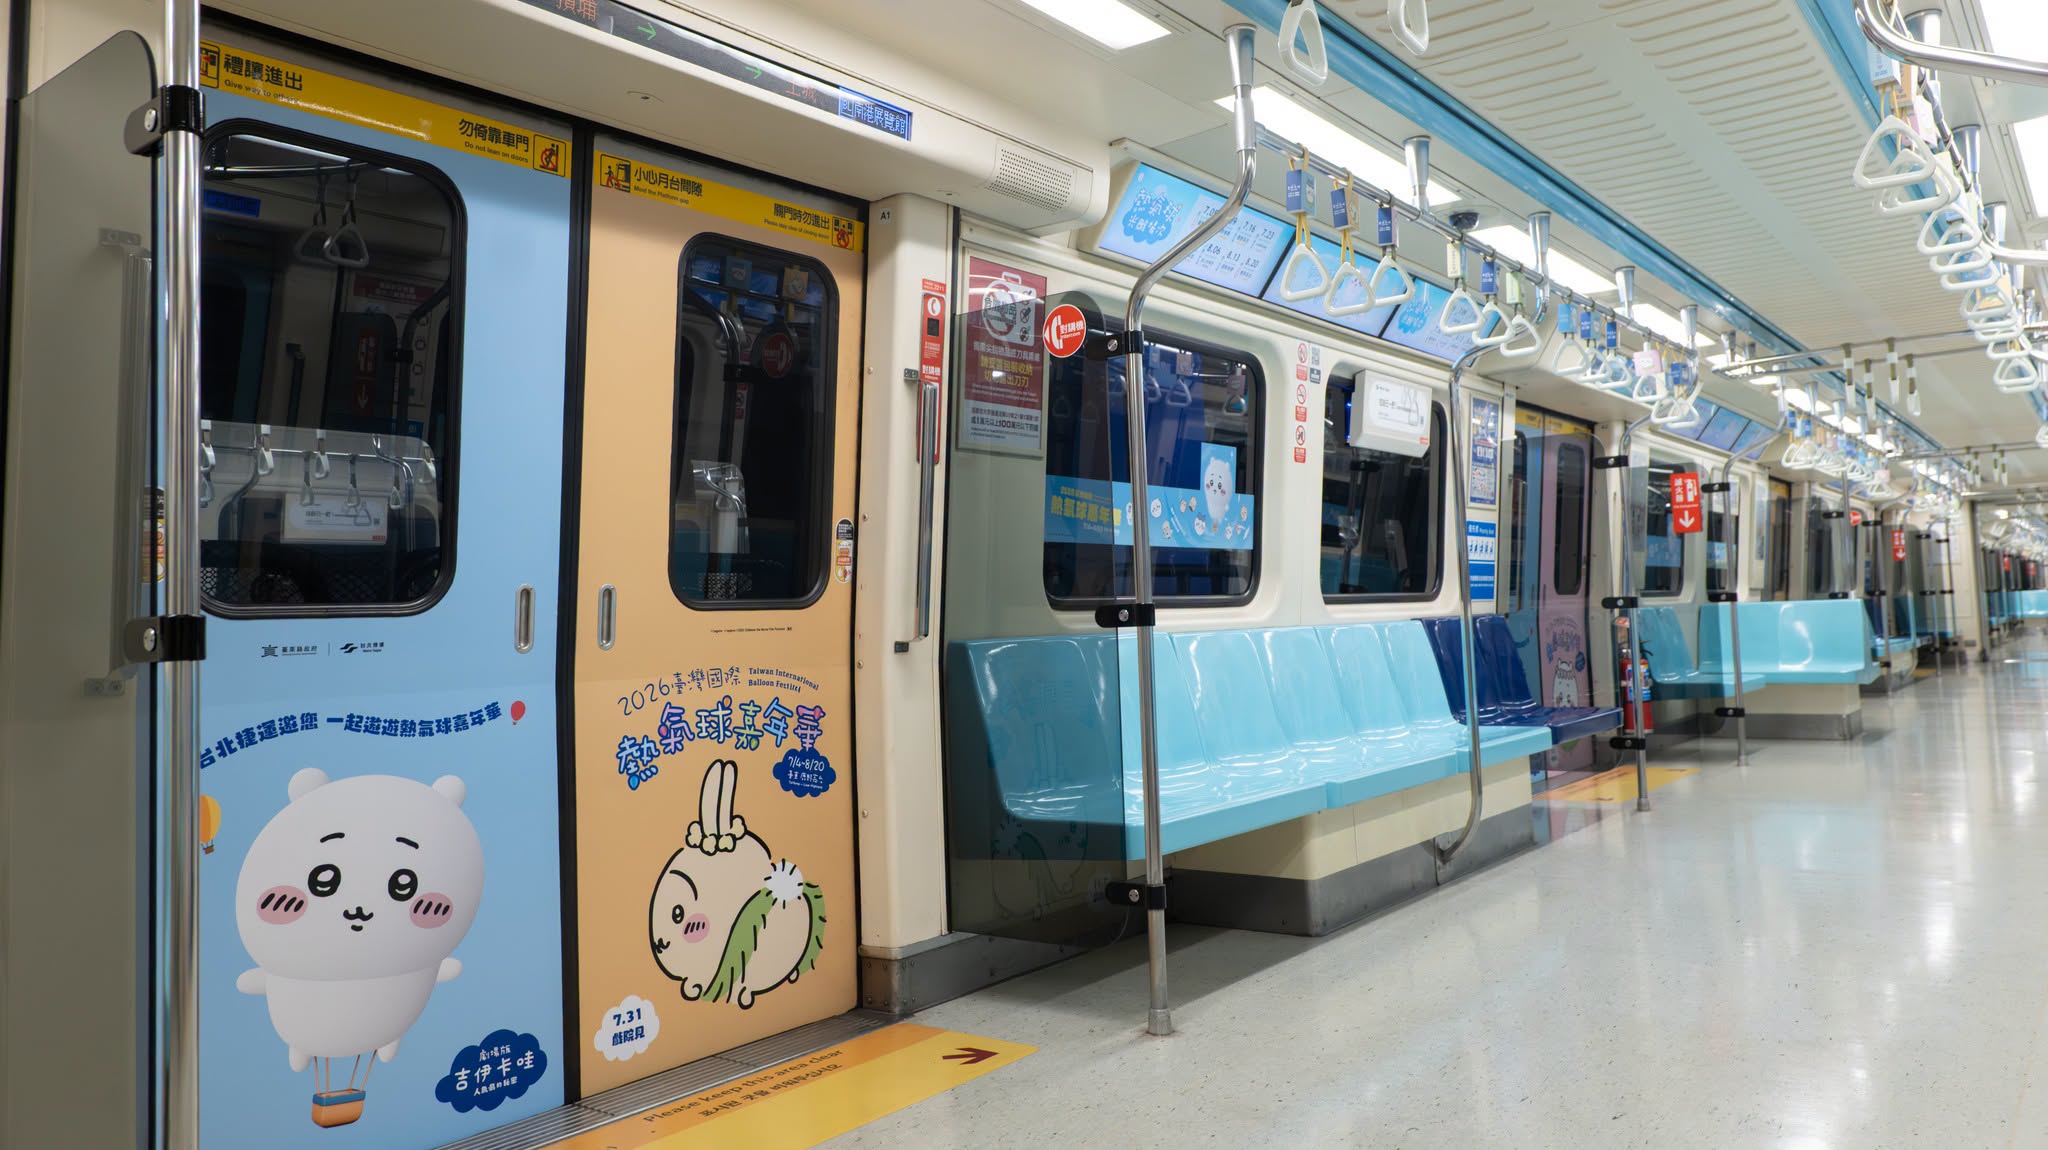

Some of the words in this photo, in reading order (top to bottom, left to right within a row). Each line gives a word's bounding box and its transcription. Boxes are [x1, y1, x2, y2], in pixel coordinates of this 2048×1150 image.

[224, 53, 303, 91] 禮讓進出
[224, 79, 243, 90] Give
[245, 85, 262, 95] way
[263, 89, 272, 98] to
[854, 101, 905, 134] 南港展覽館
[459, 118, 529, 153] 勿倚靠車門
[464, 141, 473, 149] Do
[475, 144, 486, 153] not
[510, 153, 529, 163] doors
[634, 167, 703, 197] 小心月台間隙
[774, 203, 830, 230] 關門時勿進出
[881, 211, 890, 220] A1
[1060, 320, 1084, 335] 對講機
[749, 667, 774, 676] Taiwan
[775, 669, 819, 691] International
[749, 679, 774, 688] Balloon
[200, 712, 318, 769] 台北捷運邀您
[326, 701, 502, 738] 一起遨遊熱氣球嘉年華
[616, 695, 826, 790] 熱氣球嘉年華
[613, 1008, 641, 1026] 7.31
[612, 1025, 645, 1046] 戲院見
[480, 1044, 511, 1062] 劇場版
[455, 1050, 534, 1091] 吉伊卡哇
[643, 1100, 701, 1122] Please
[698, 1086, 743, 1102] keep
[742, 1074, 774, 1087] this
[774, 1062, 809, 1076] area
[808, 1050, 844, 1065] clear
